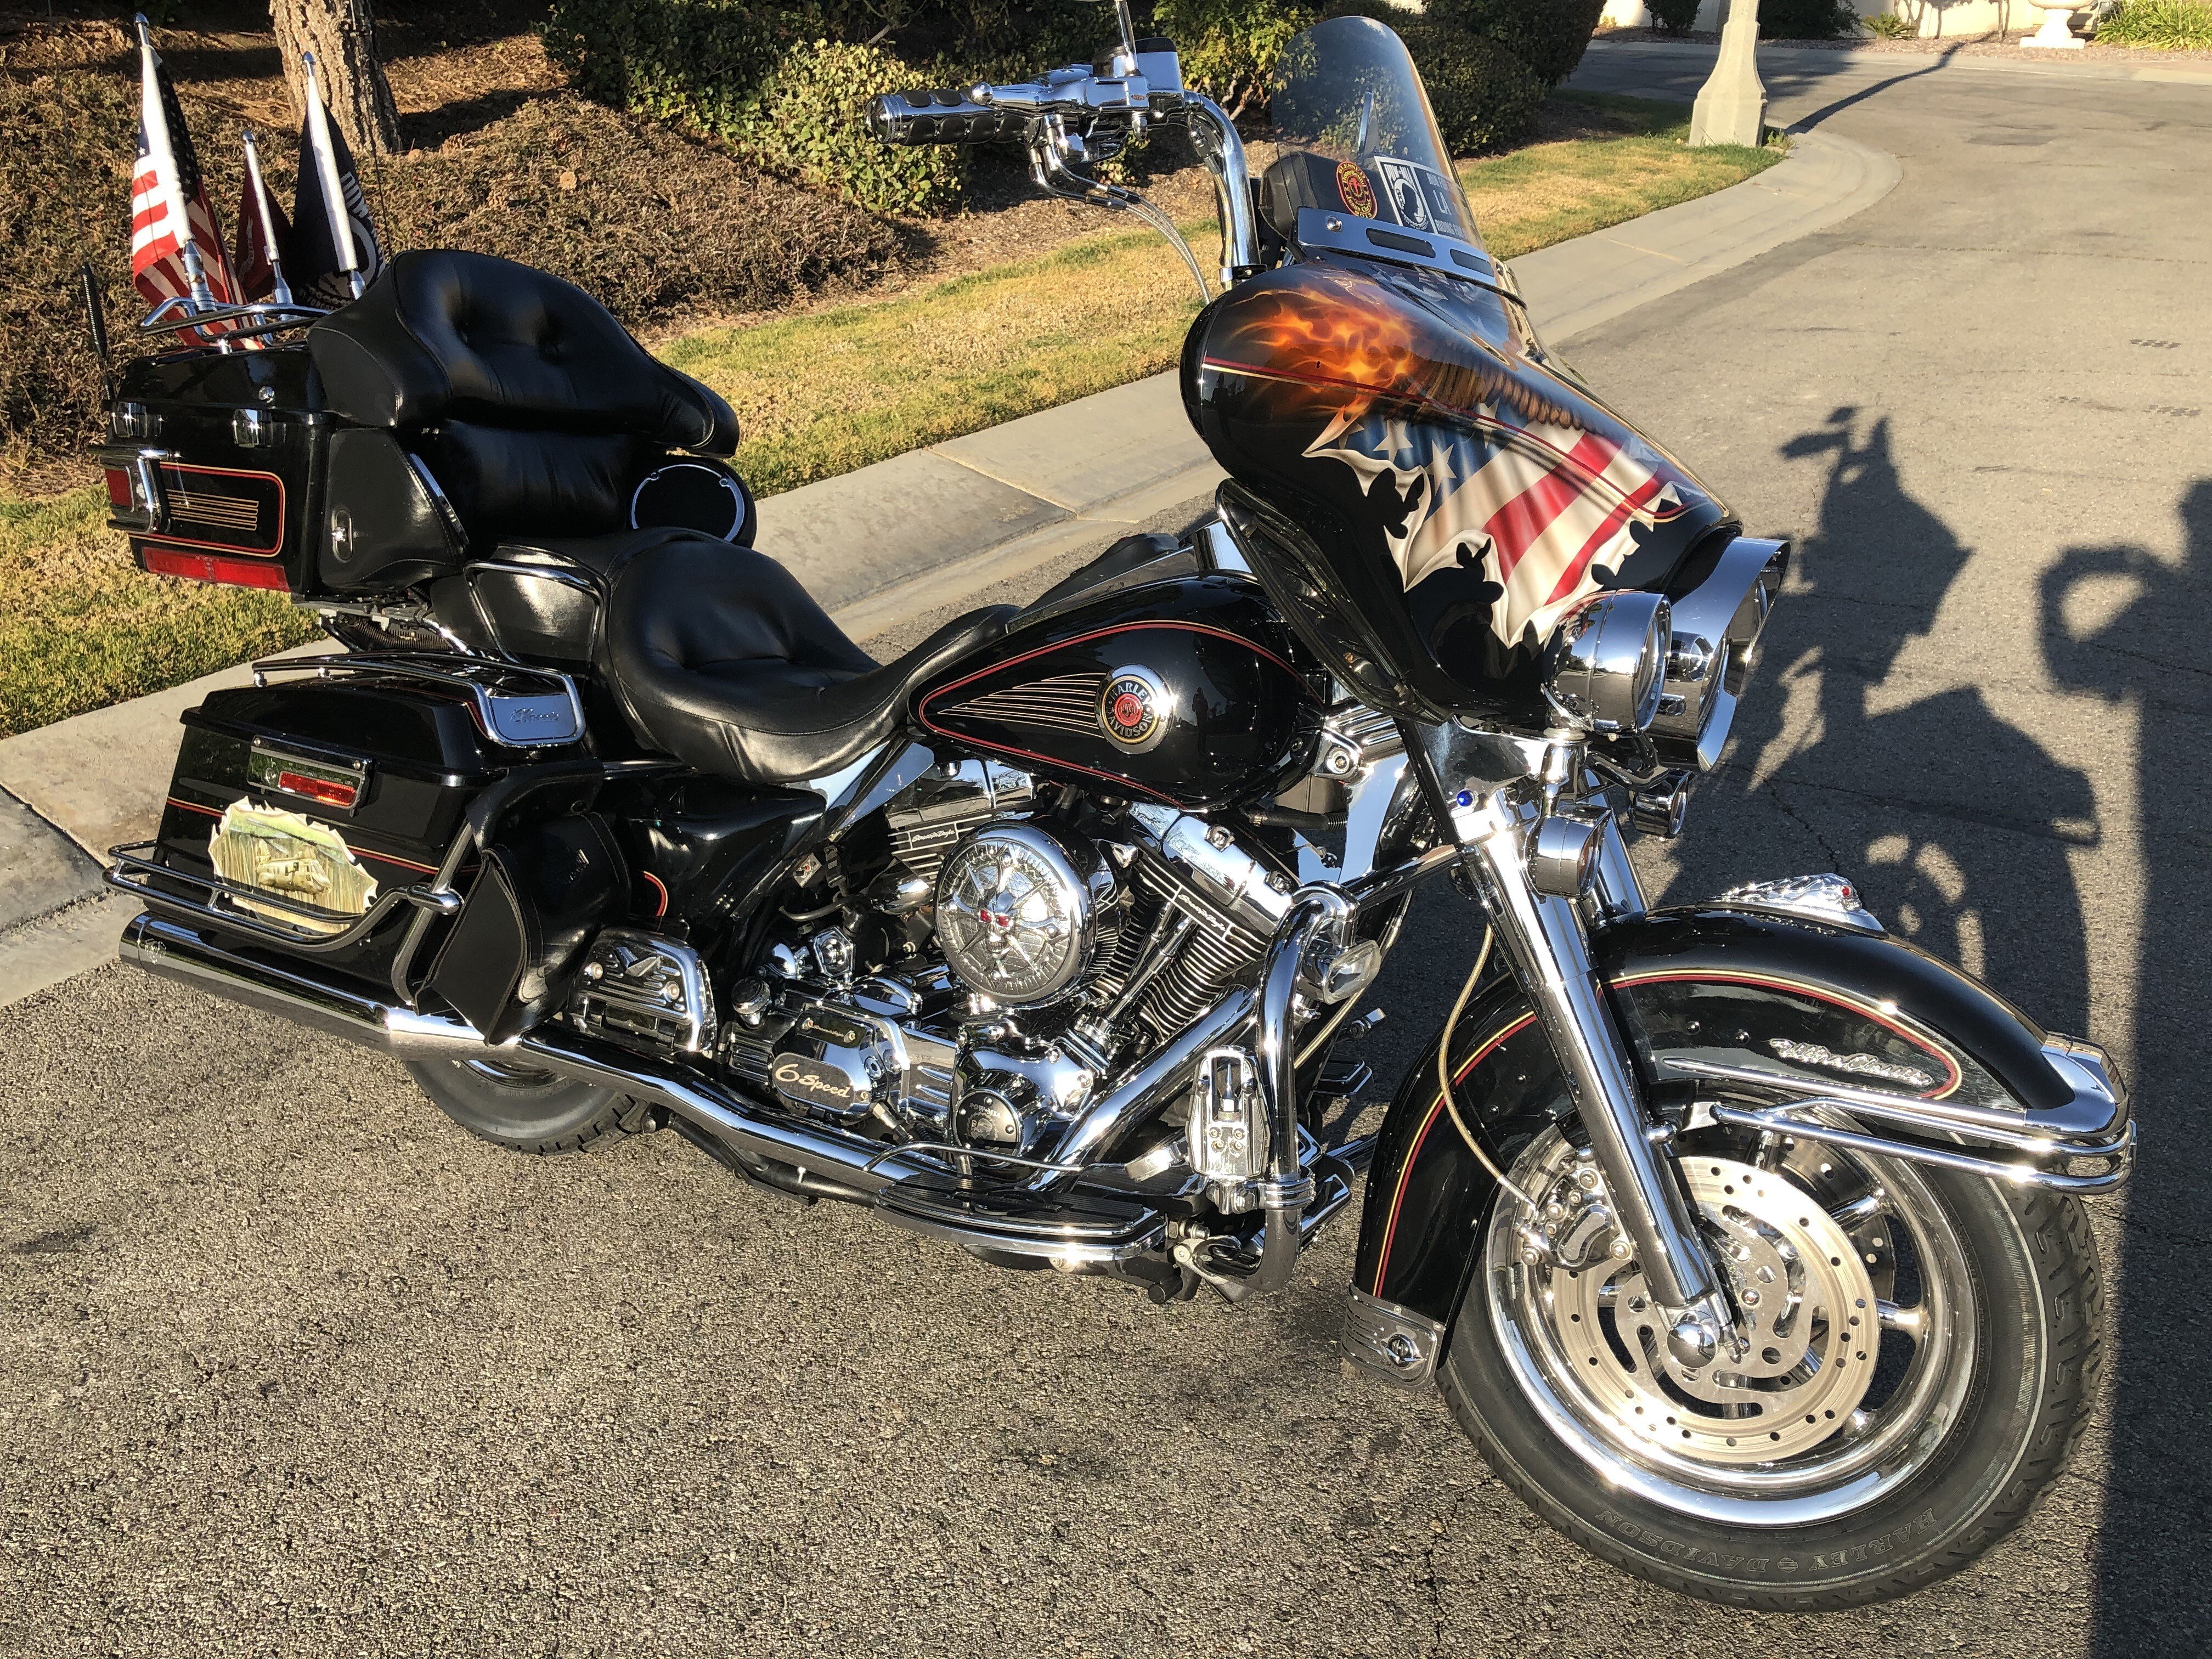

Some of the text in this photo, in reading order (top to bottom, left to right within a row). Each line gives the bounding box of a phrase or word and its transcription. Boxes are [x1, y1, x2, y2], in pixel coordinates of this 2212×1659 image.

[1105, 682, 1154, 738] HARLEY DAVIDSON
[775, 1063, 851, 1098] 6 Speed
[1595, 1508, 1937, 1572] HARLEY DAVIDSON
